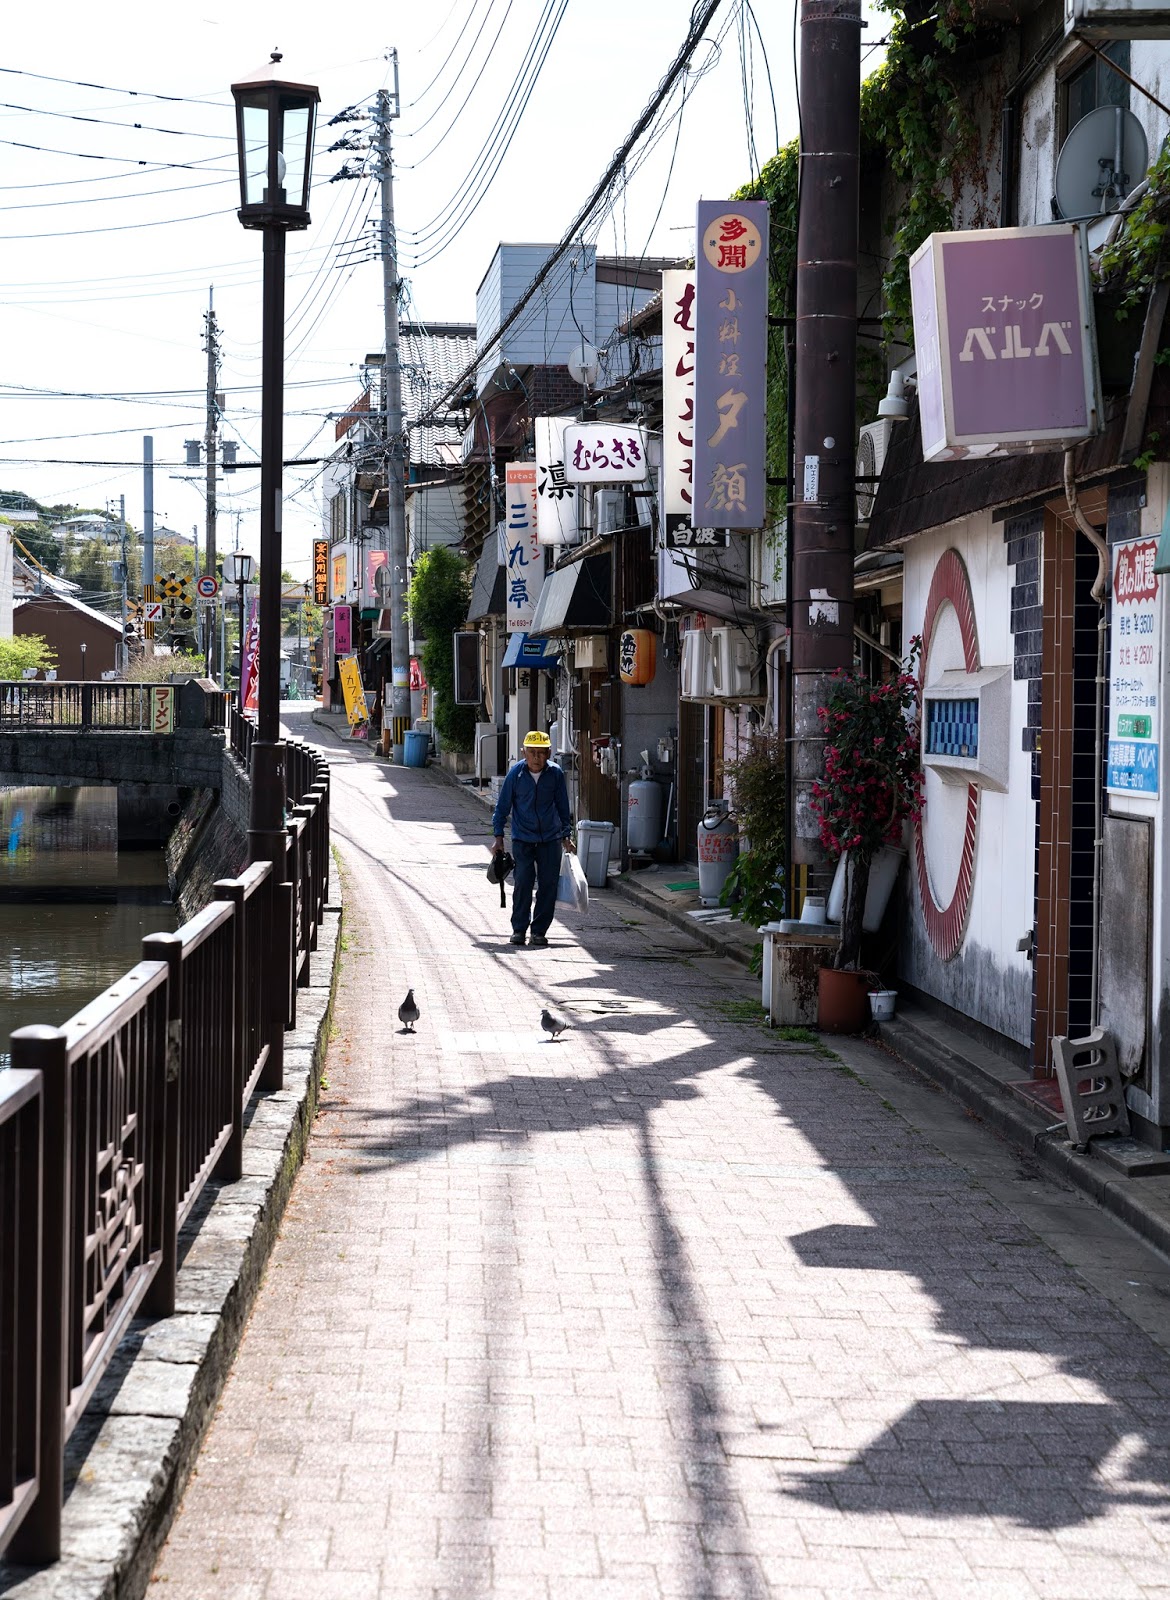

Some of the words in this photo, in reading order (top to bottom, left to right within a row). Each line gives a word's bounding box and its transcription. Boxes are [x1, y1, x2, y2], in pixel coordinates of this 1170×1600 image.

[717, 218, 748, 269] 多聞
[981, 292, 1044, 313] スナック
[718, 287, 743, 377] 小料理
[959, 321, 1073, 362] ベルベ
[572, 437, 642, 471] むらさき
[703, 387, 749, 513] 夕顔
[508, 503, 530, 609] 三九亭
[1118, 547, 1156, 596] 飲み放題
[1119, 616, 1131, 635] 男性
[1119, 646, 1131, 665] 女性
[154, 689, 170, 730] ラーメン
[346, 674, 358, 704] カフェ
